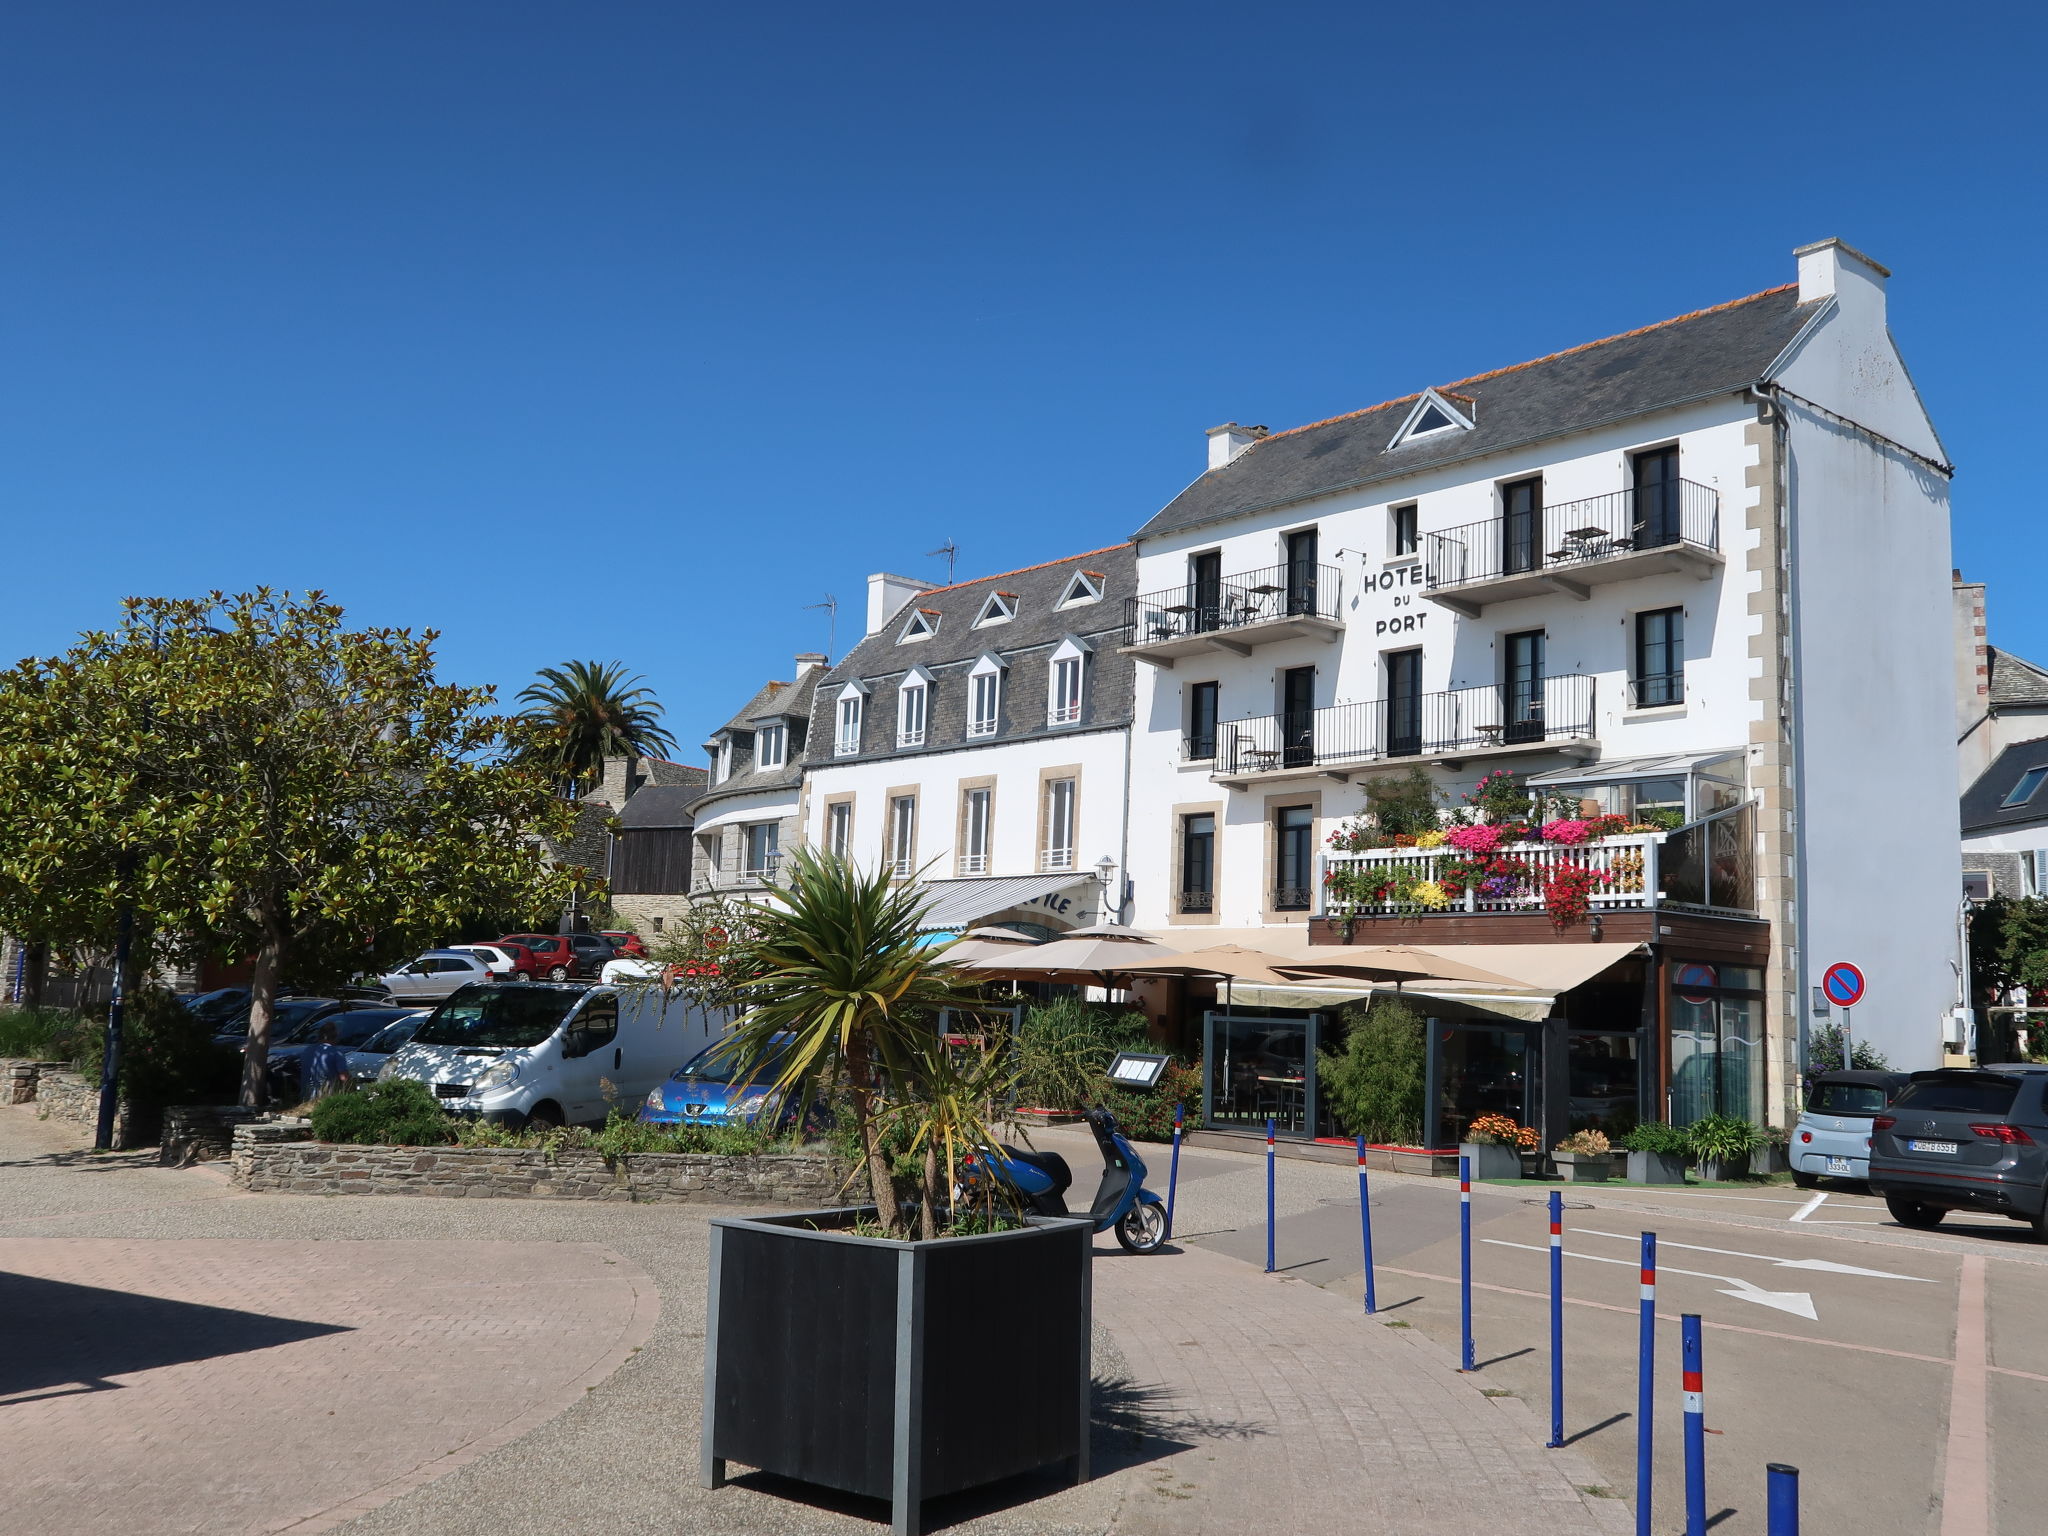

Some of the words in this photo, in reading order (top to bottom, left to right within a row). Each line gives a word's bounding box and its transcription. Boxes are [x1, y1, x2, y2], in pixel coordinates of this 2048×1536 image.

[1364, 564, 1437, 594] HOTEL
[1394, 595, 1410, 607] DU
[1376, 612, 1428, 637] PORT
